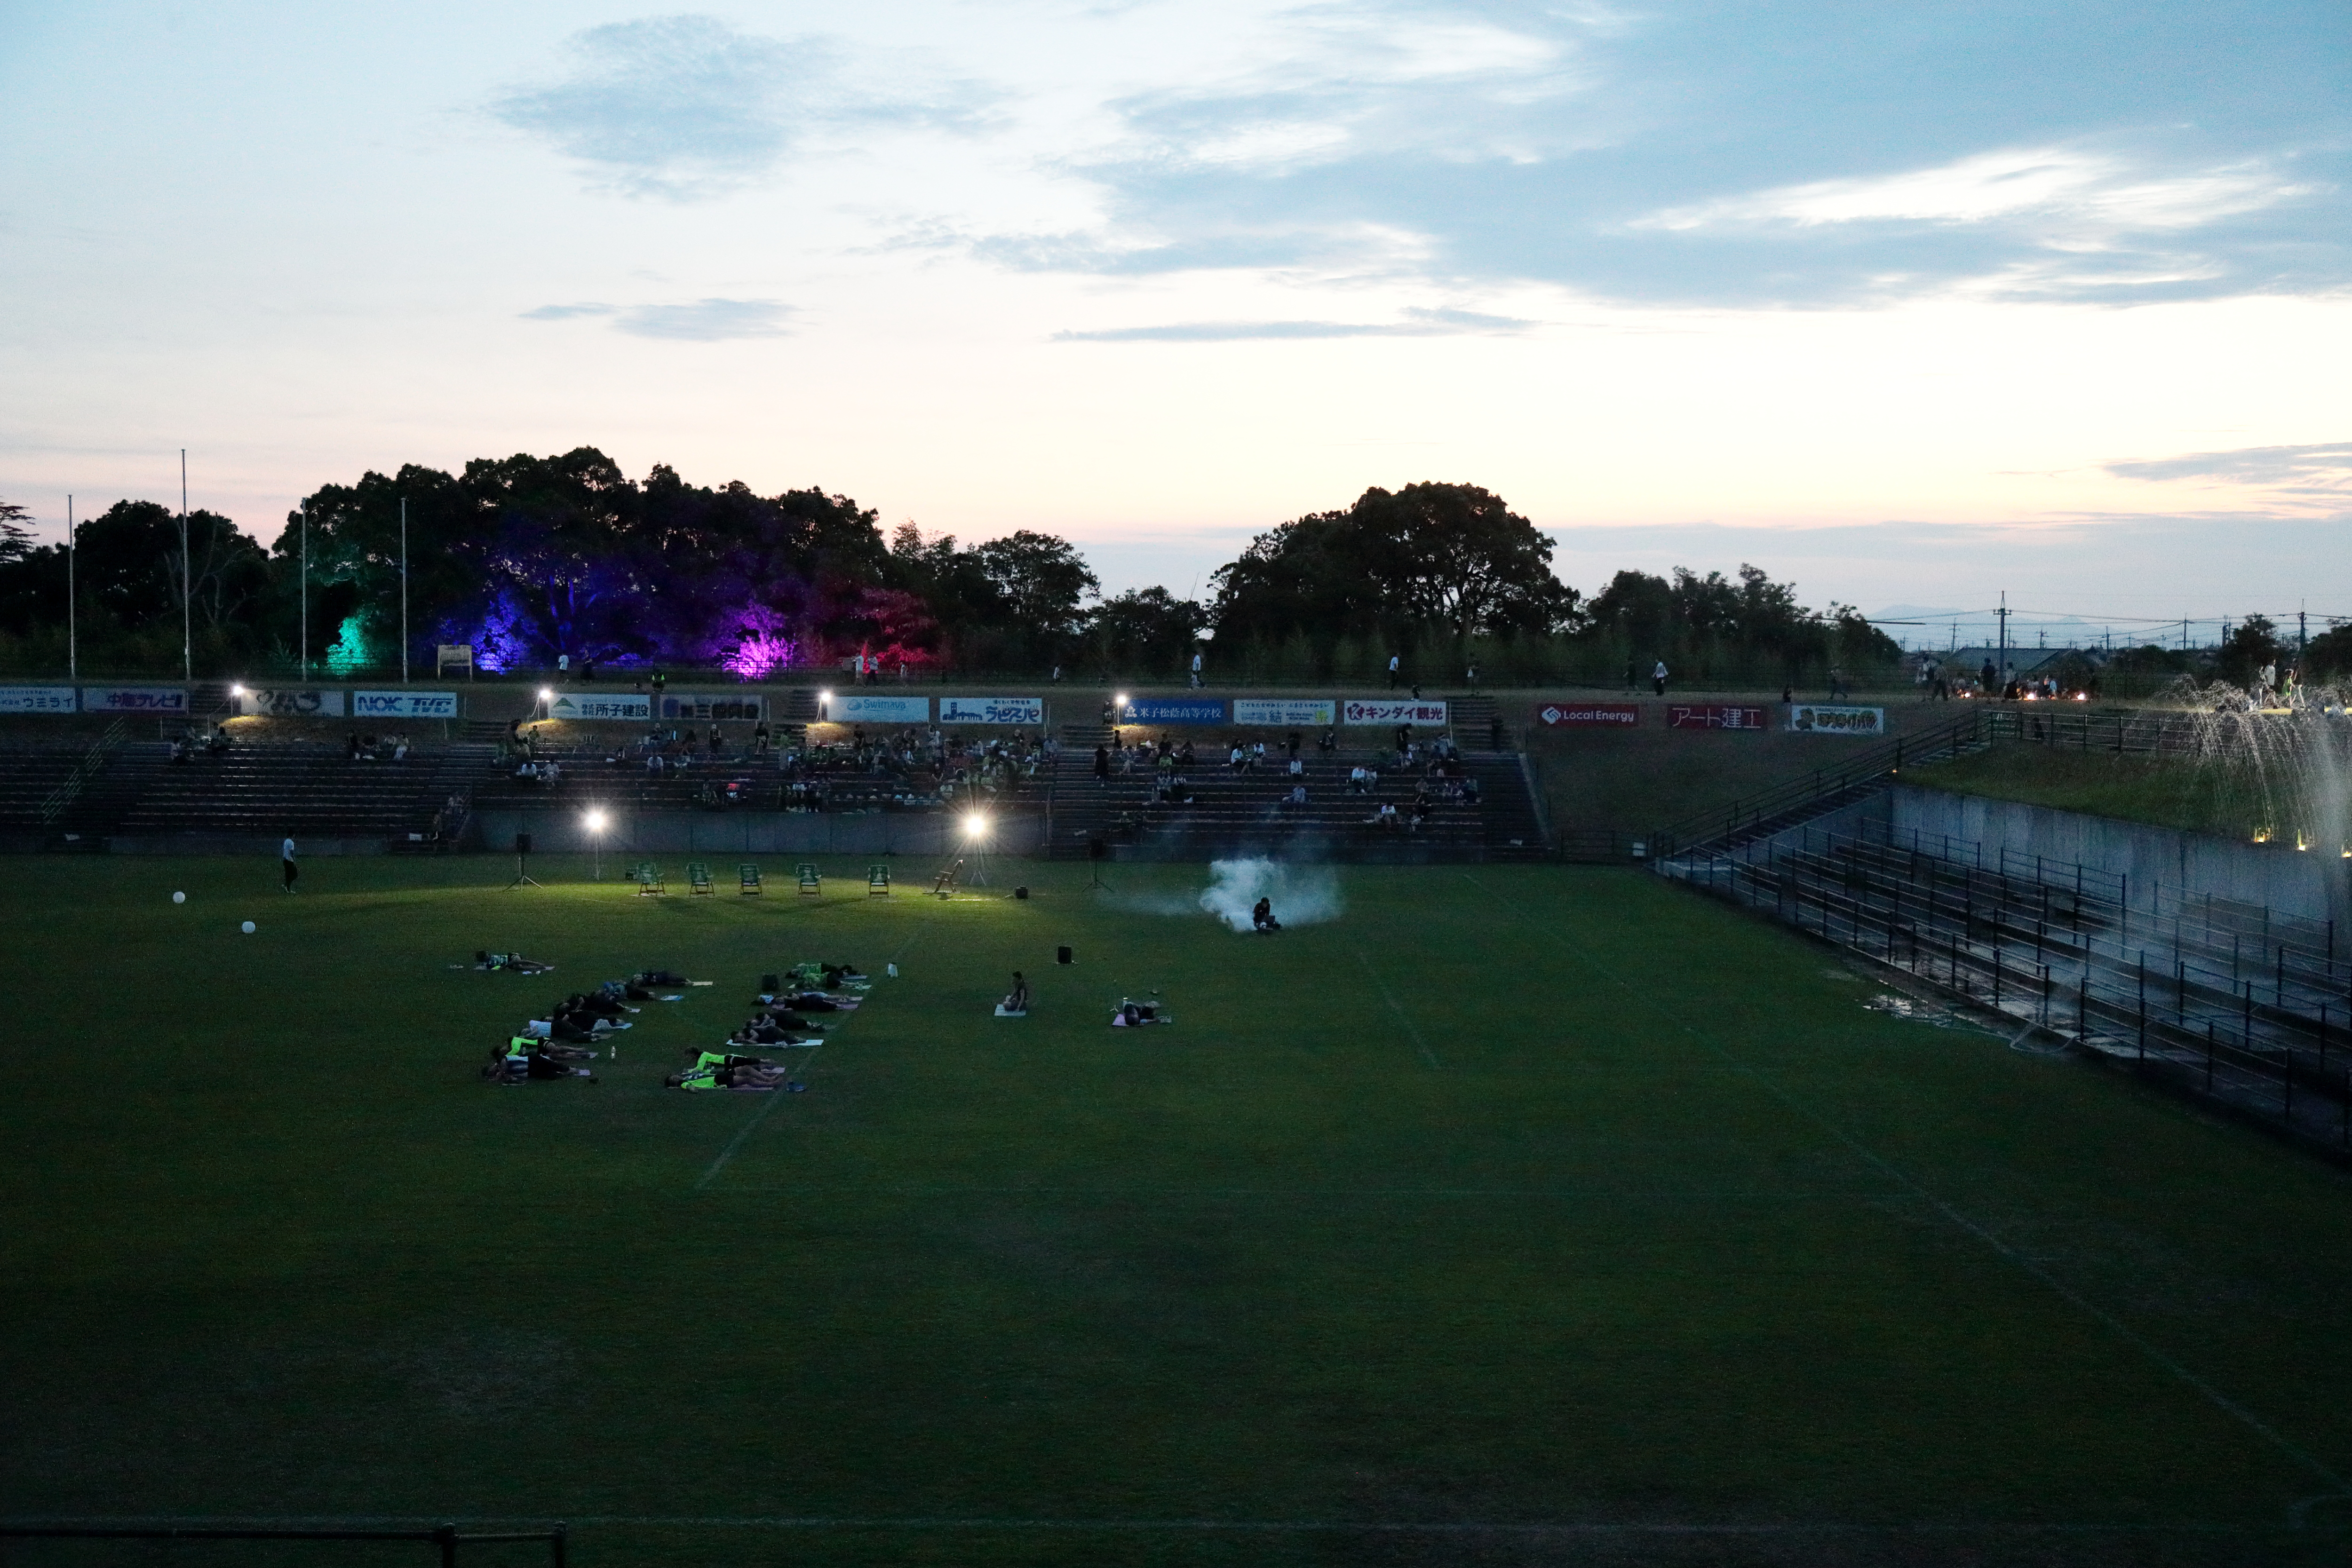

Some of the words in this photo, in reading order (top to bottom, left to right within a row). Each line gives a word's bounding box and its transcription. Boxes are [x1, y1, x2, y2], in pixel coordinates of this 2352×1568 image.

[23, 697, 73, 707] ウミライ
[358, 697, 403, 712] NOK
[596, 704, 649, 716] 所子建設
[1366, 706, 1443, 720] キンダイ観光
[1564, 710, 1593, 720] Local
[1596, 711, 1634, 722] Energy
[1672, 707, 1761, 729] アート建工
